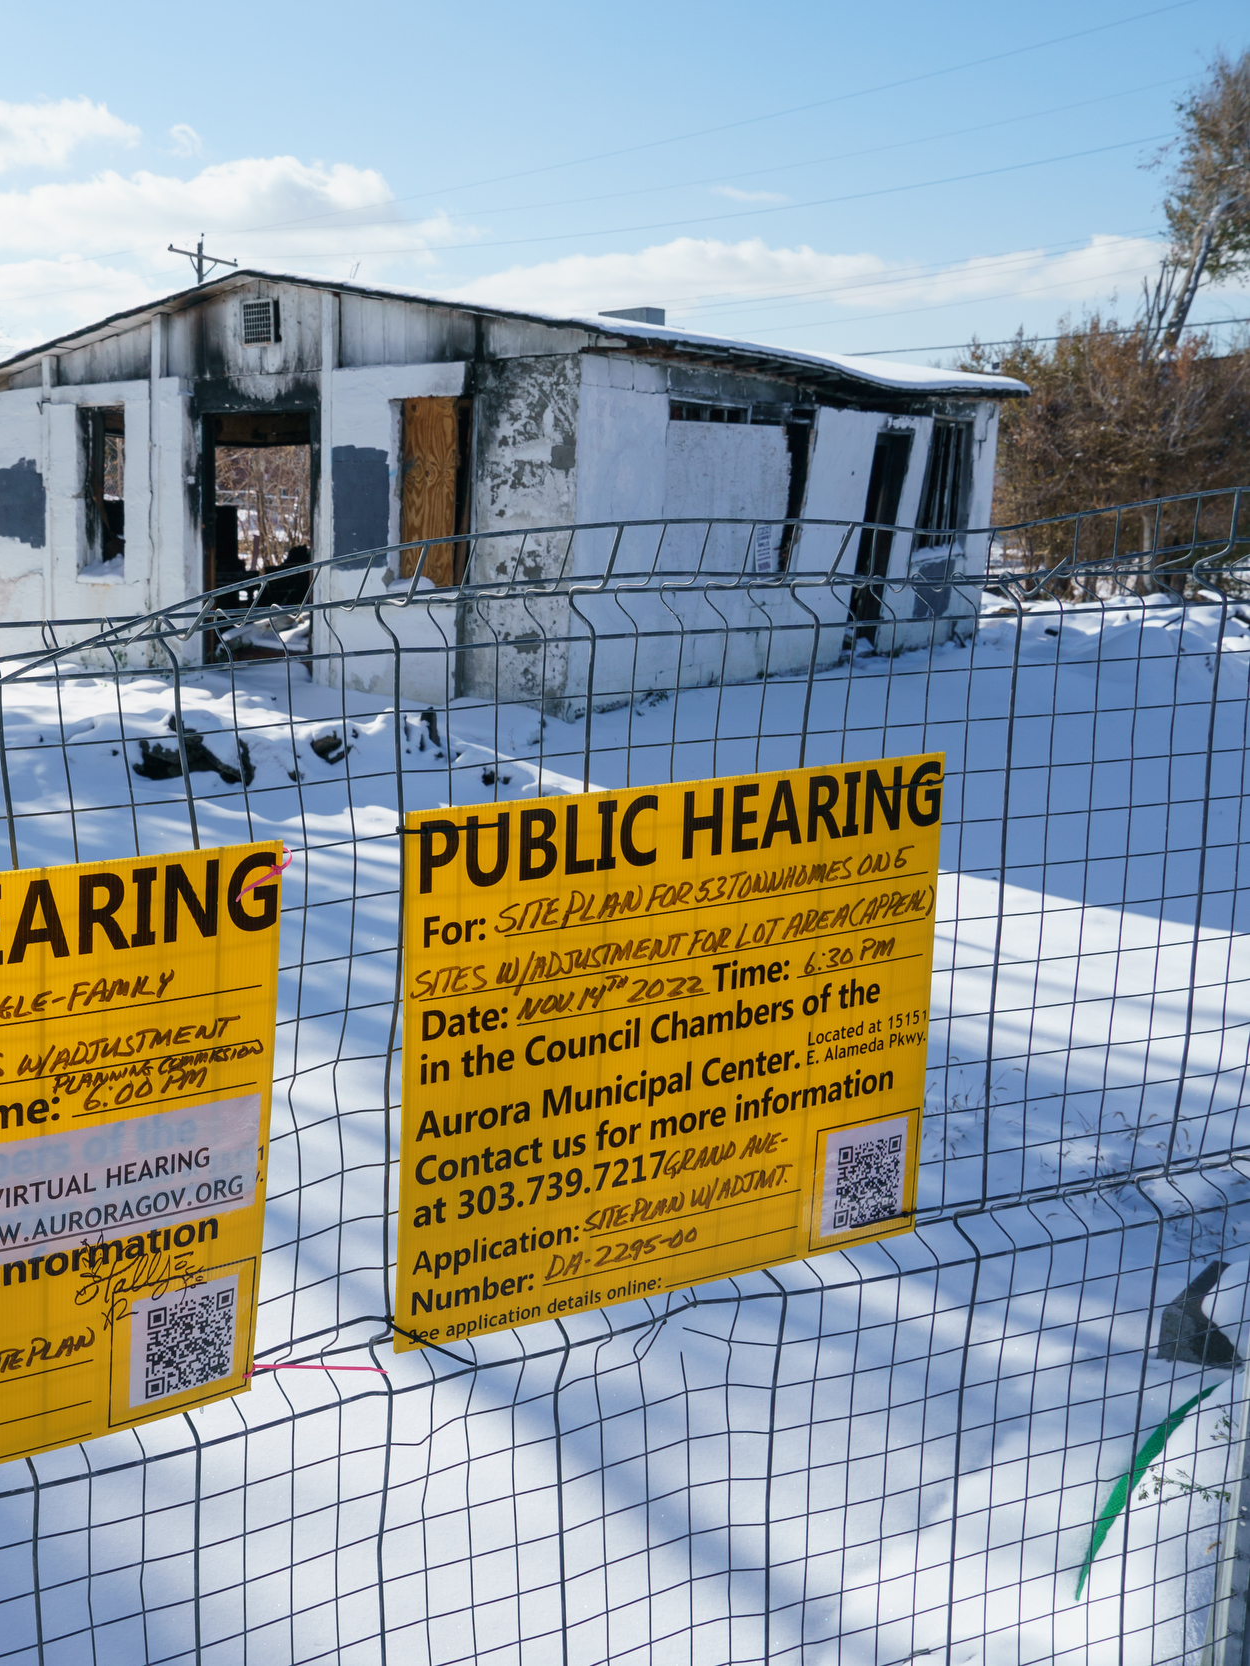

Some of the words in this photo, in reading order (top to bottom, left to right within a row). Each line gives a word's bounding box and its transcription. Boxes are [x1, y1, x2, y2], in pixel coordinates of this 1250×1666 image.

[419, 795, 658, 894] PUBLIC
[682, 761, 941, 860] HEARING
[494, 897, 559, 933] SITE
[560, 885, 643, 928] PLAN
[644, 880, 694, 912] FOR
[695, 875, 728, 903] 53
[729, 856, 852, 900] TOWNHOMES
[857, 852, 890, 876] ON
[893, 845, 915, 868] 5
[423, 915, 486, 948] For:
[410, 964, 487, 999] SITES
[687, 926, 731, 956] FOR
[735, 917, 785, 951] LOT
[712, 959, 790, 993] Time:
[804, 947, 853, 975] 6:30
[859, 936, 896, 960] PM
[626, 975, 704, 1004] 2022
[420, 1053, 450, 1086] in
[461, 1044, 515, 1078] the
[524, 1017, 641, 1066] Council
[650, 998, 794, 1044] Chambers
[802, 982, 833, 1016] of
[838, 978, 881, 1010] the
[422, 1005, 508, 1041] Date:
[807, 1021, 864, 1046] Located
[868, 1019, 882, 1034] at
[888, 1009, 927, 1030] 15151
[807, 1050, 819, 1066] E.
[824, 1038, 884, 1063] Alameda
[889, 1030, 926, 1049] Pkwy.
[53, 1060, 154, 1095] PLANNING
[83, 1077, 153, 1111] 6:00
[161, 1066, 208, 1094] PM
[415, 1100, 530, 1141] Aurora
[542, 1061, 692, 1118] Municipal
[701, 1049, 800, 1087] Center.
[415, 1137, 542, 1185] Contact
[552, 1133, 586, 1159] us
[596, 1120, 641, 1150] for
[650, 1106, 726, 1140] more
[735, 1069, 894, 1123] information
[106, 1147, 210, 1188] HEARING
[663, 1141, 736, 1179] GRAND
[413, 1197, 446, 1228] at
[457, 1150, 666, 1220] 303.739.7217
[412, 1225, 579, 1279] Application:
[544, 1227, 697, 1281] DA-2295-00
[409, 1329, 438, 1345] See
[446, 1307, 540, 1340] application
[547, 1291, 601, 1314] details
[607, 1277, 661, 1300] online:
[411, 1272, 534, 1316] Number:
